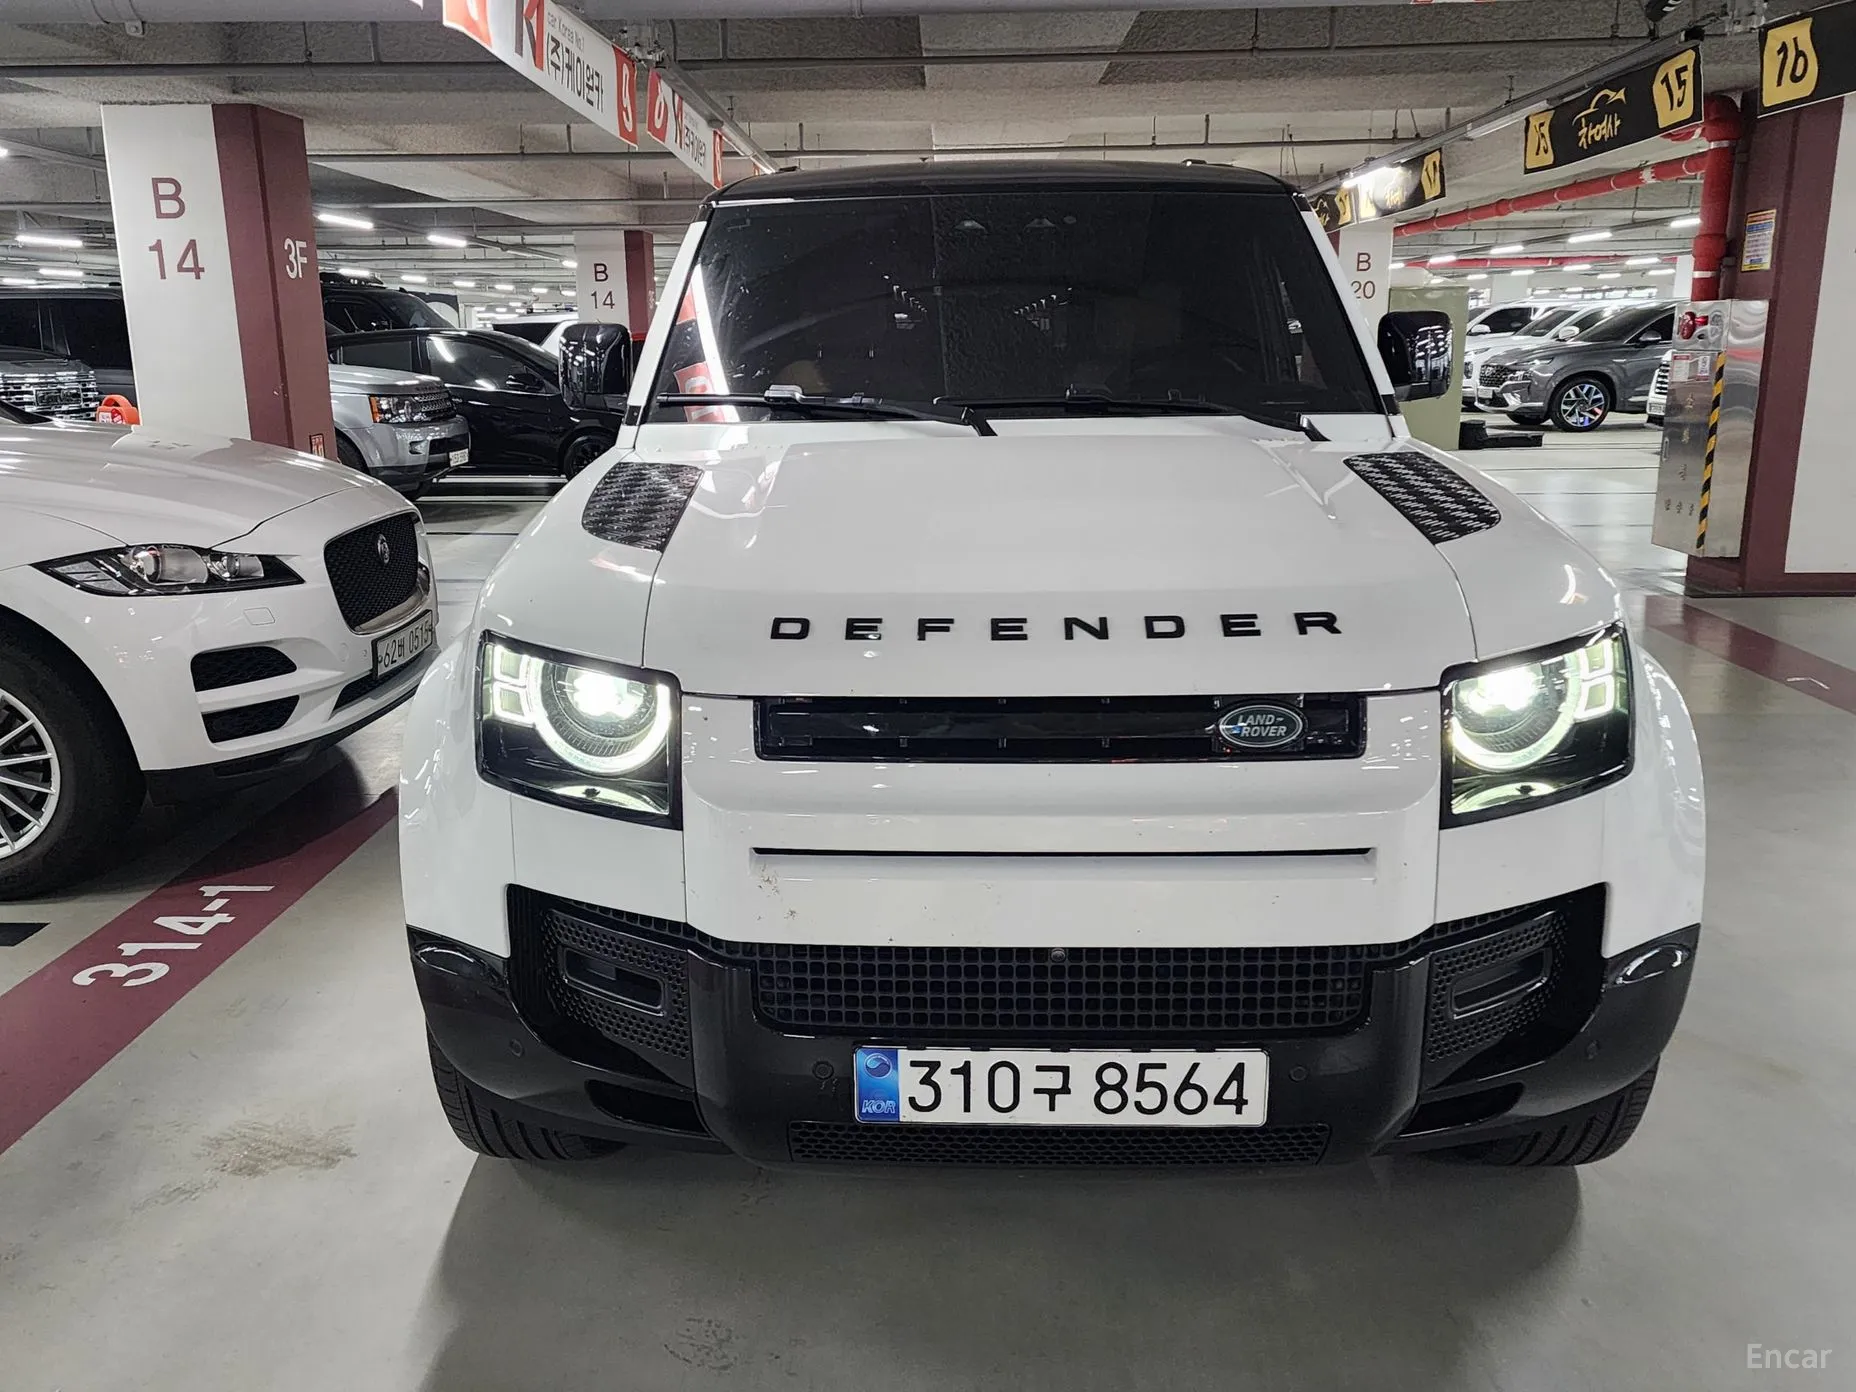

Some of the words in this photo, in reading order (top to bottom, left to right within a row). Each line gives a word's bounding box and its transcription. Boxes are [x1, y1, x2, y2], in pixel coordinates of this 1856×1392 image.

[1775, 36, 1809, 88] 16
[1660, 64, 1689, 112] 15
[1534, 120, 1549, 157] 15
[151, 177, 186, 219] B
[148, 239, 206, 280] 14
[283, 237, 308, 280] 3F
[593, 263, 609, 282] B
[1356, 252, 1372, 272] B
[590, 290, 615, 309] 14
[1350, 280, 1376, 299] 20
[770, 611, 1342, 641] DEFENDER
[1240, 726, 1288, 737] ROVER
[72, 884, 276, 988] 314-1
[907, 1059, 1072, 1114] 310구
[1093, 1061, 1249, 1116] 8564
[861, 1098, 897, 1115] KOR
